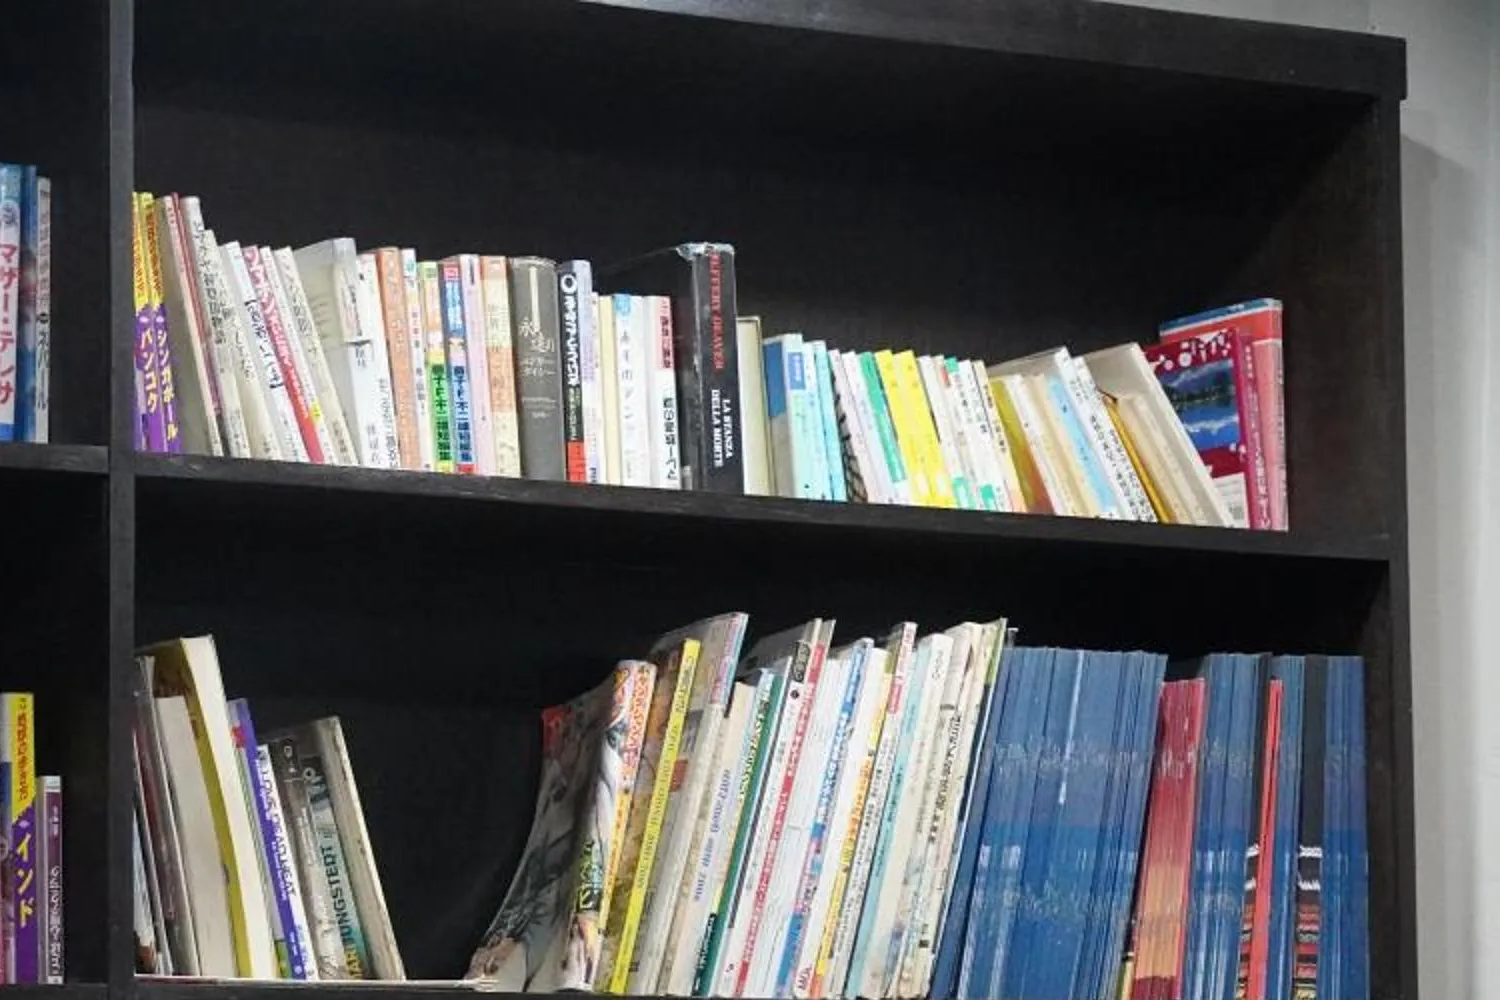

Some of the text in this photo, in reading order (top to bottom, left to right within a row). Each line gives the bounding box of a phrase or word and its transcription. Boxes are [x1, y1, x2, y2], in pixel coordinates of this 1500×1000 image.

[140, 328, 159, 414] バンコク
[16, 832, 35, 928] インド
